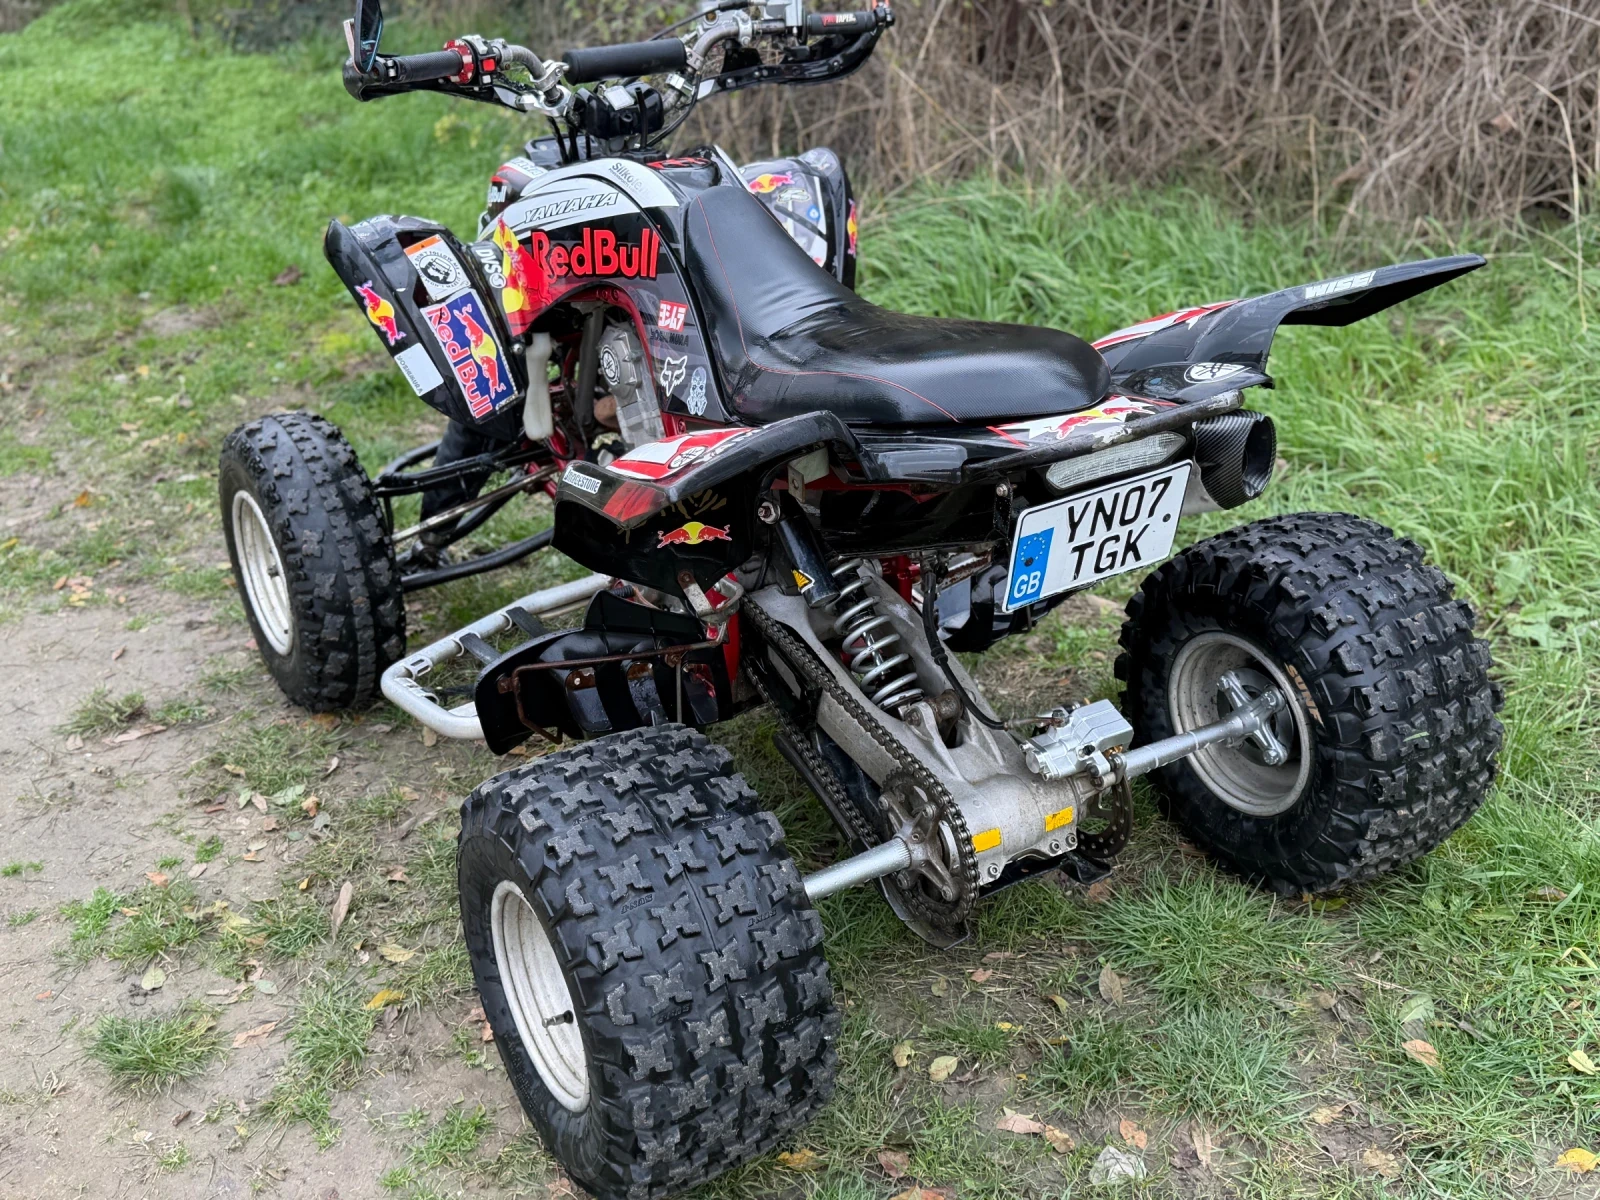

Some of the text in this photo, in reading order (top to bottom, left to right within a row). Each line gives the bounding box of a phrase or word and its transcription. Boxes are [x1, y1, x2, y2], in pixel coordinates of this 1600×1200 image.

[524, 191, 619, 224] YAMAHA
[1067, 475, 1173, 543] YN07
[1070, 523, 1151, 582] TGK
[1013, 570, 1042, 599] GB
